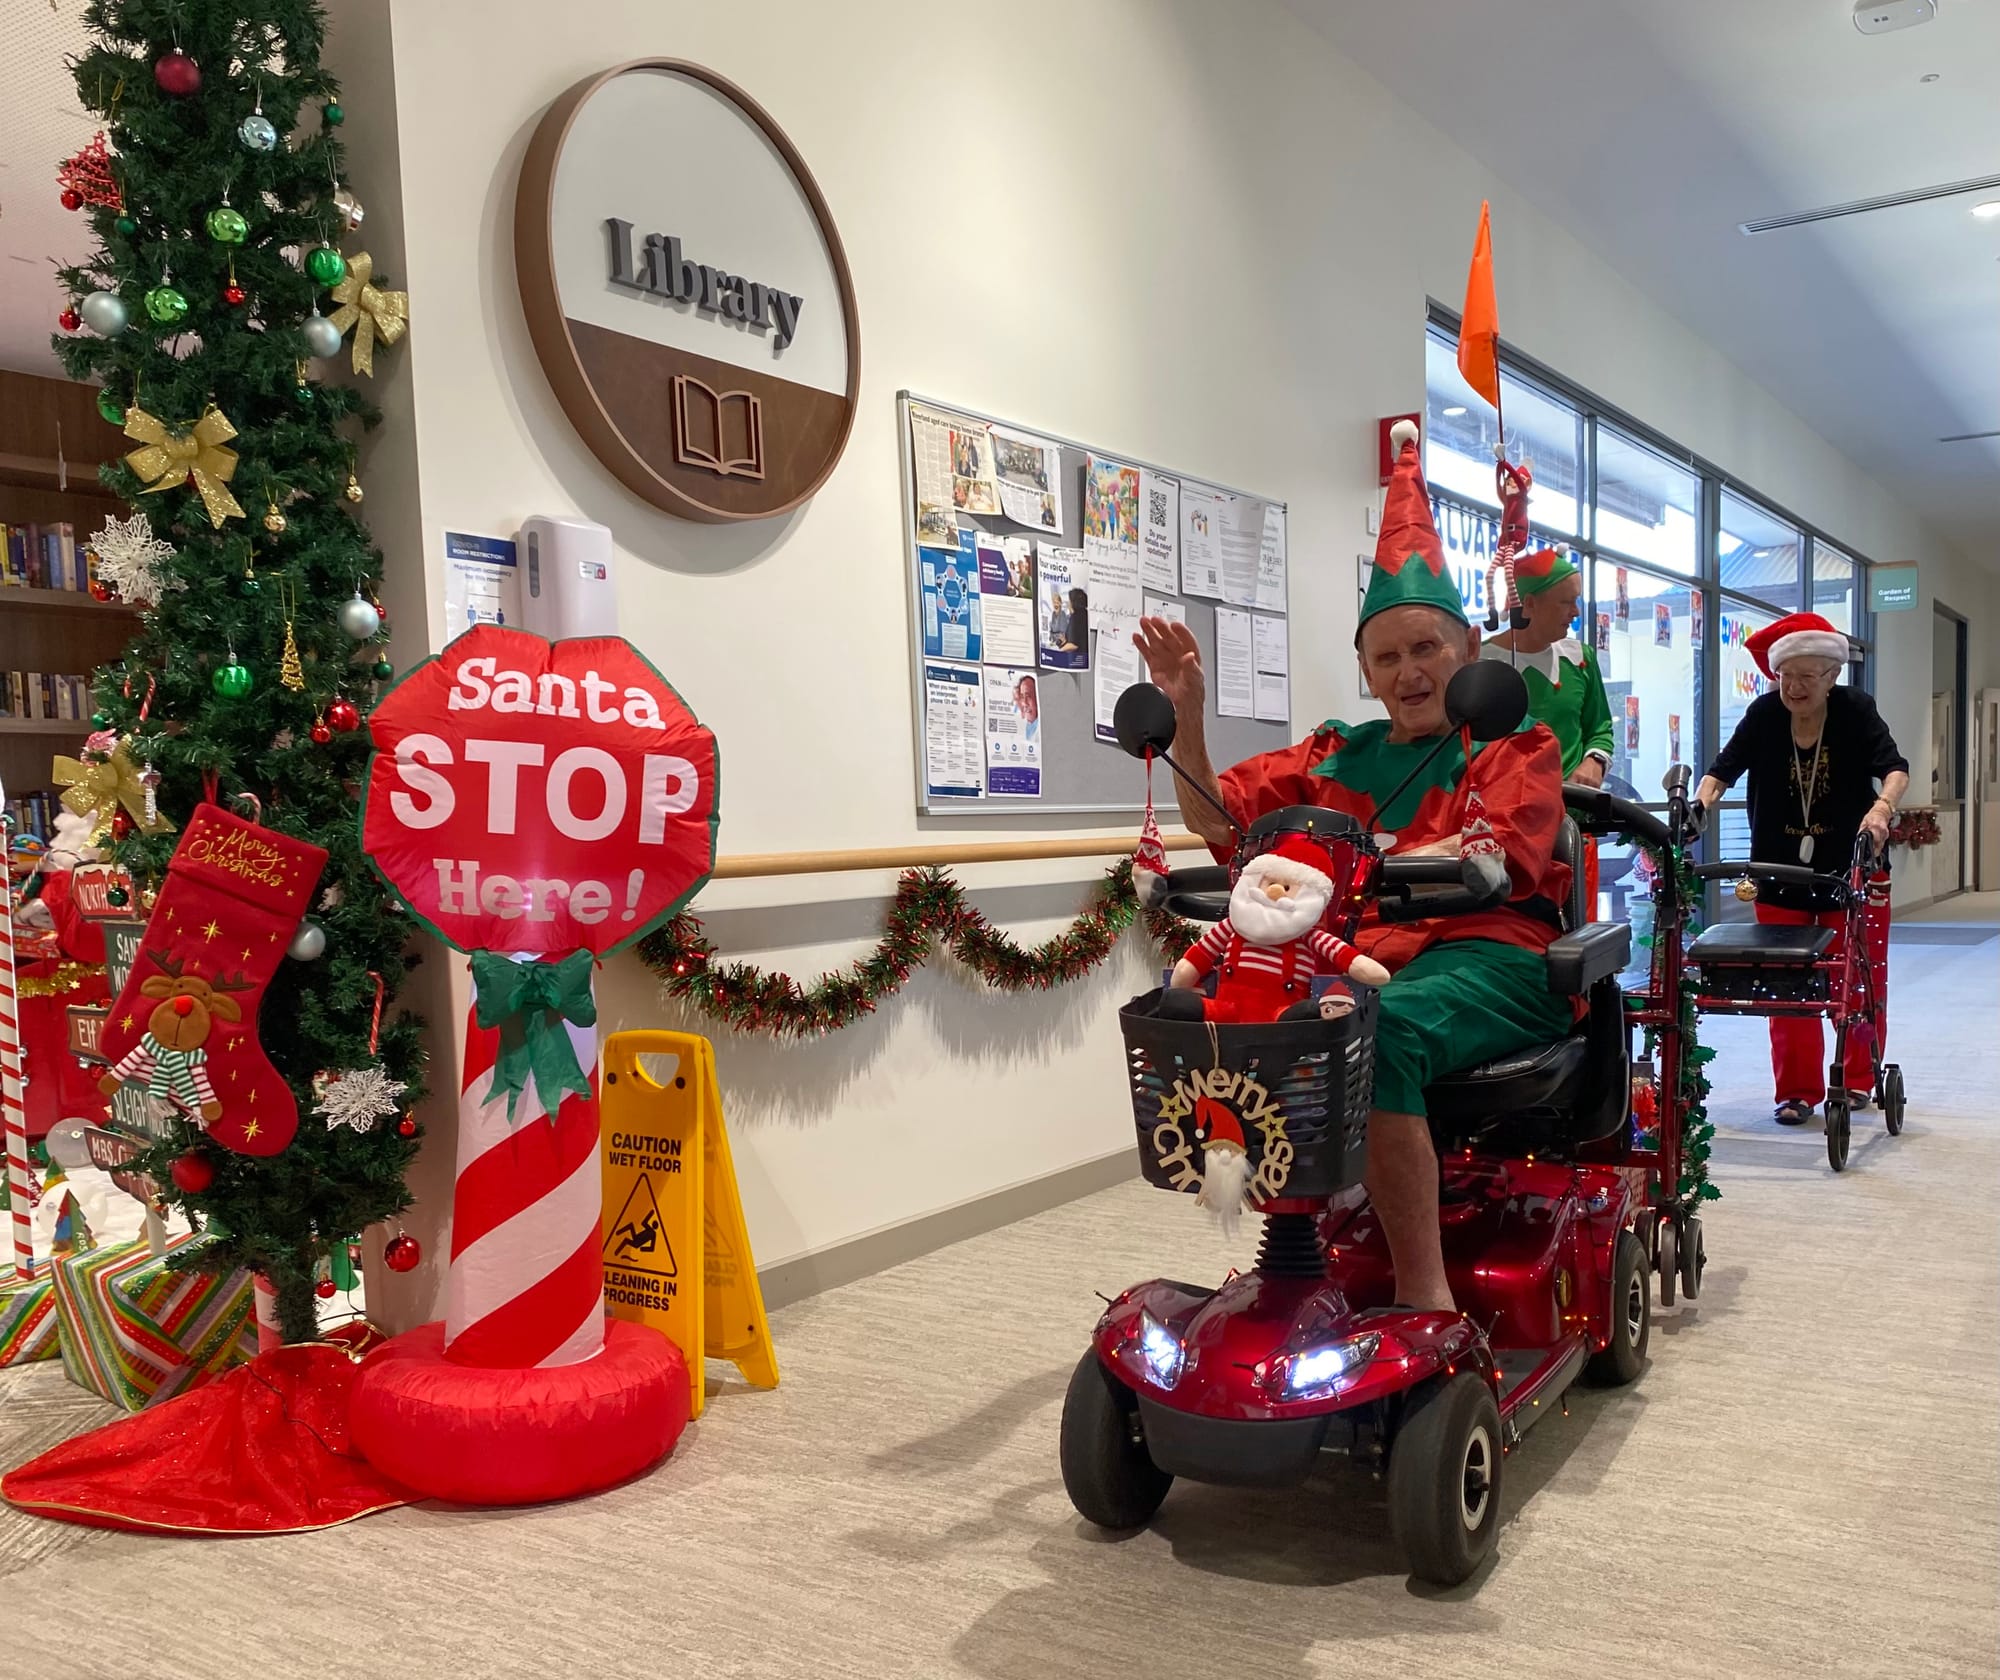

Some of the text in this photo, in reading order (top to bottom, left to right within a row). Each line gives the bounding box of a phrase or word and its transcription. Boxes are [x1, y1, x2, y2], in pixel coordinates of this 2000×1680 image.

[606, 217, 804, 350] Library
[452, 548, 469, 556] ROOM
[1043, 572, 1072, 583] powerful
[1050, 562, 1068, 573] voice
[1878, 588, 1902, 596] Garden
[1884, 594, 1911, 602] Respect
[448, 657, 666, 730] Santa
[390, 733, 699, 845] STOP
[188, 839, 285, 887] Christmas
[218, 828, 285, 871] Merry
[78, 882, 107, 912] NORTH
[432, 858, 645, 925] Here!
[116, 933, 143, 963] SANT
[77, 1018, 96, 1049] Elf
[1173, 1067, 1281, 1121] Merry
[611, 1132, 682, 1156] CAUTION
[608, 1151, 681, 1173] WET FLOOR
[604, 1271, 677, 1296] LEANING IN
[603, 1288, 670, 1312] PROGRESS
